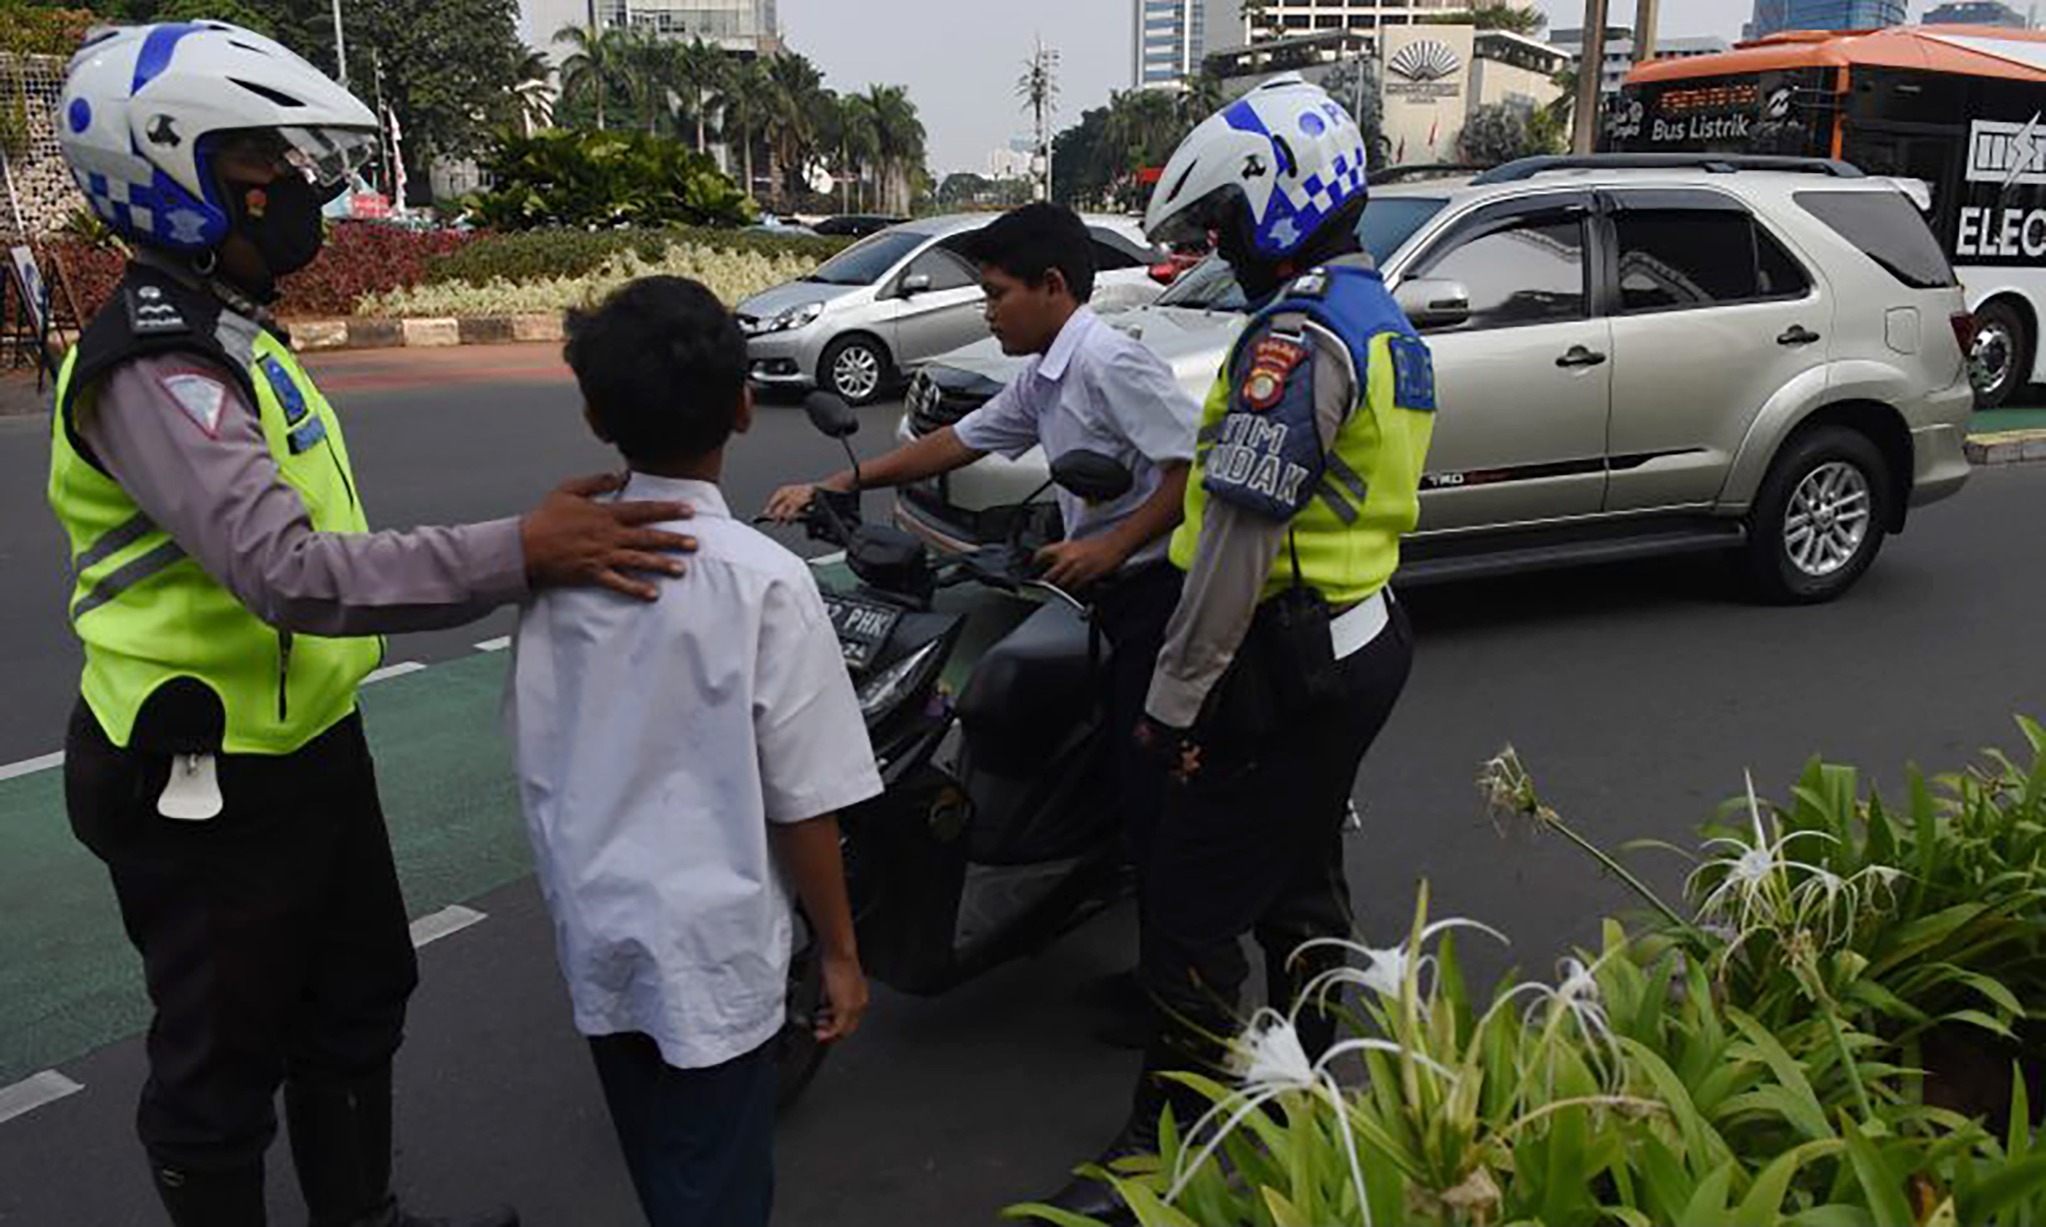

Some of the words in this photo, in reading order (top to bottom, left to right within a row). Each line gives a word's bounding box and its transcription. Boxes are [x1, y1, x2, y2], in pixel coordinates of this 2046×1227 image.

[1652, 118, 1685, 141] Bus
[1689, 113, 1750, 139] Listrik
[1222, 412, 1289, 455] TIM
